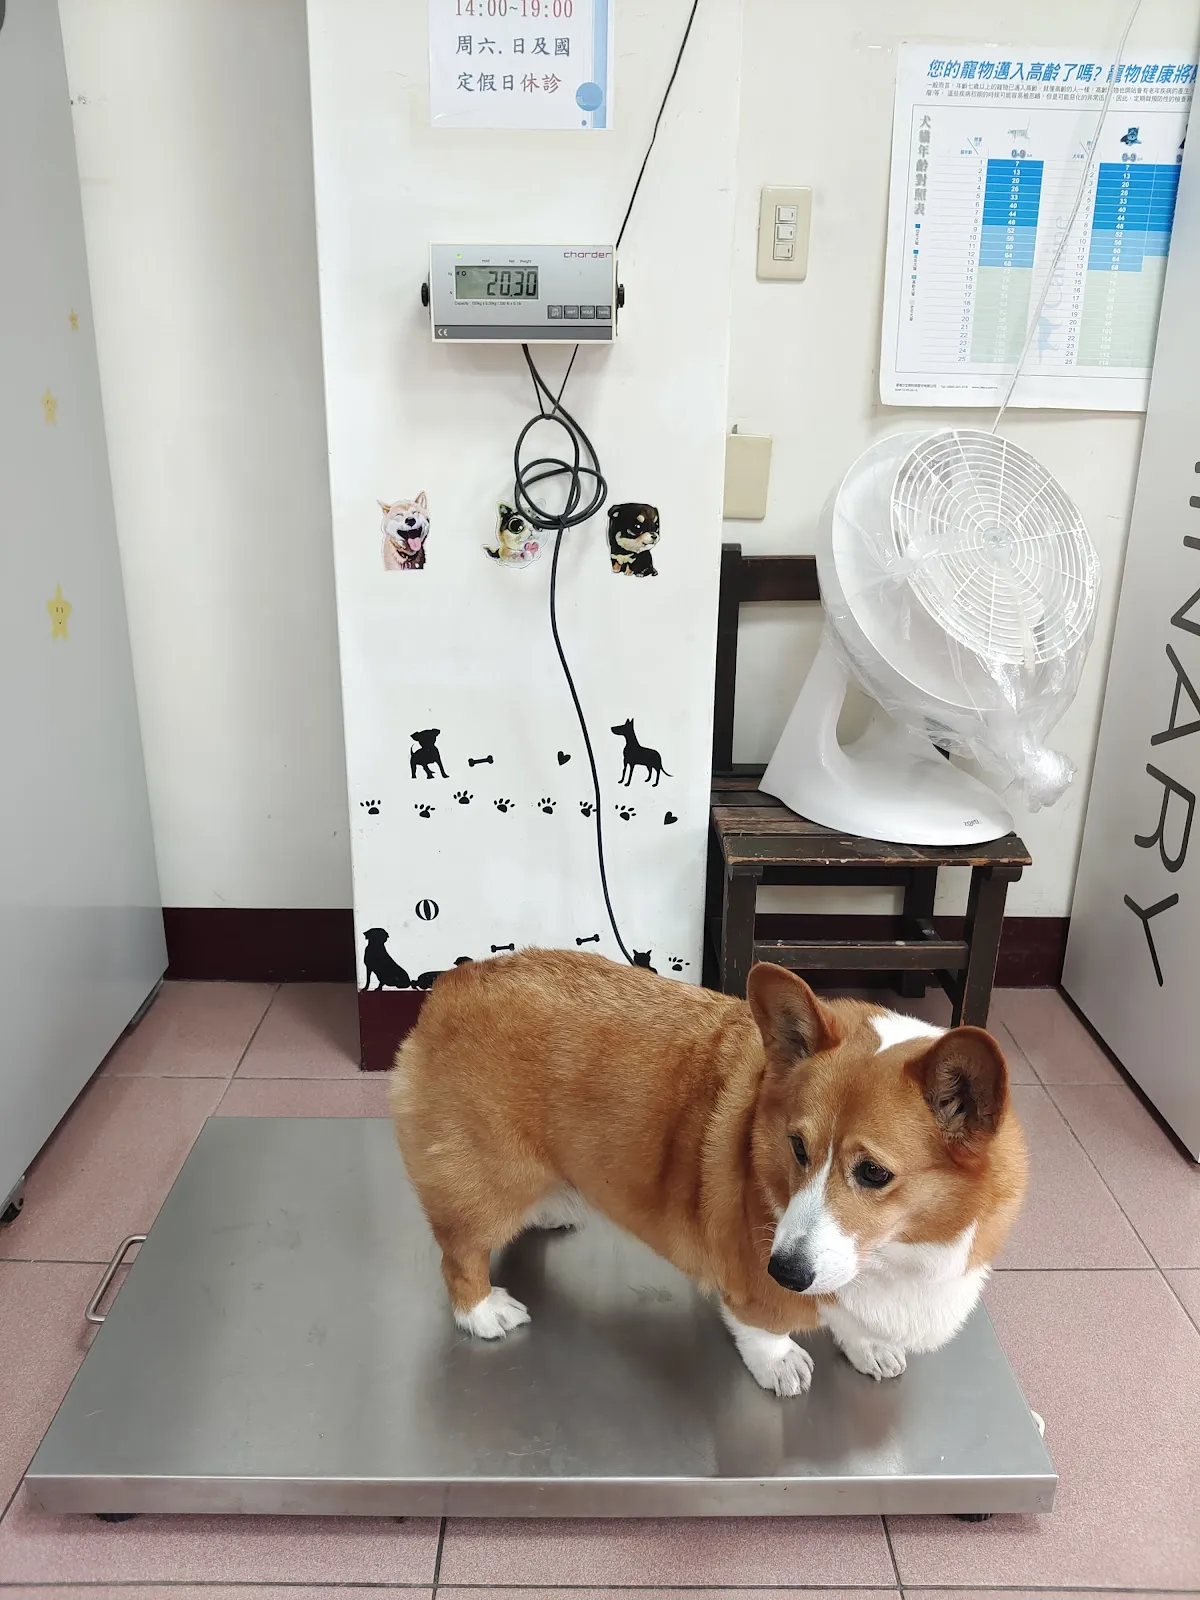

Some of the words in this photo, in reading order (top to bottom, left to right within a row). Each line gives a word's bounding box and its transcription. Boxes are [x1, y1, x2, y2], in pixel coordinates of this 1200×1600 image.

[455, 0, 573, 18] 14:00~19:00
[456, 72, 562, 94] 定假日休診
[1011, 149, 1026, 158] 0-9
[1122, 152, 1136, 162] 0-9
[914, 114, 932, 216] 犬貓年齡對照表
[564, 250, 612, 259] charder
[486, 270, 537, 297] 20.30
